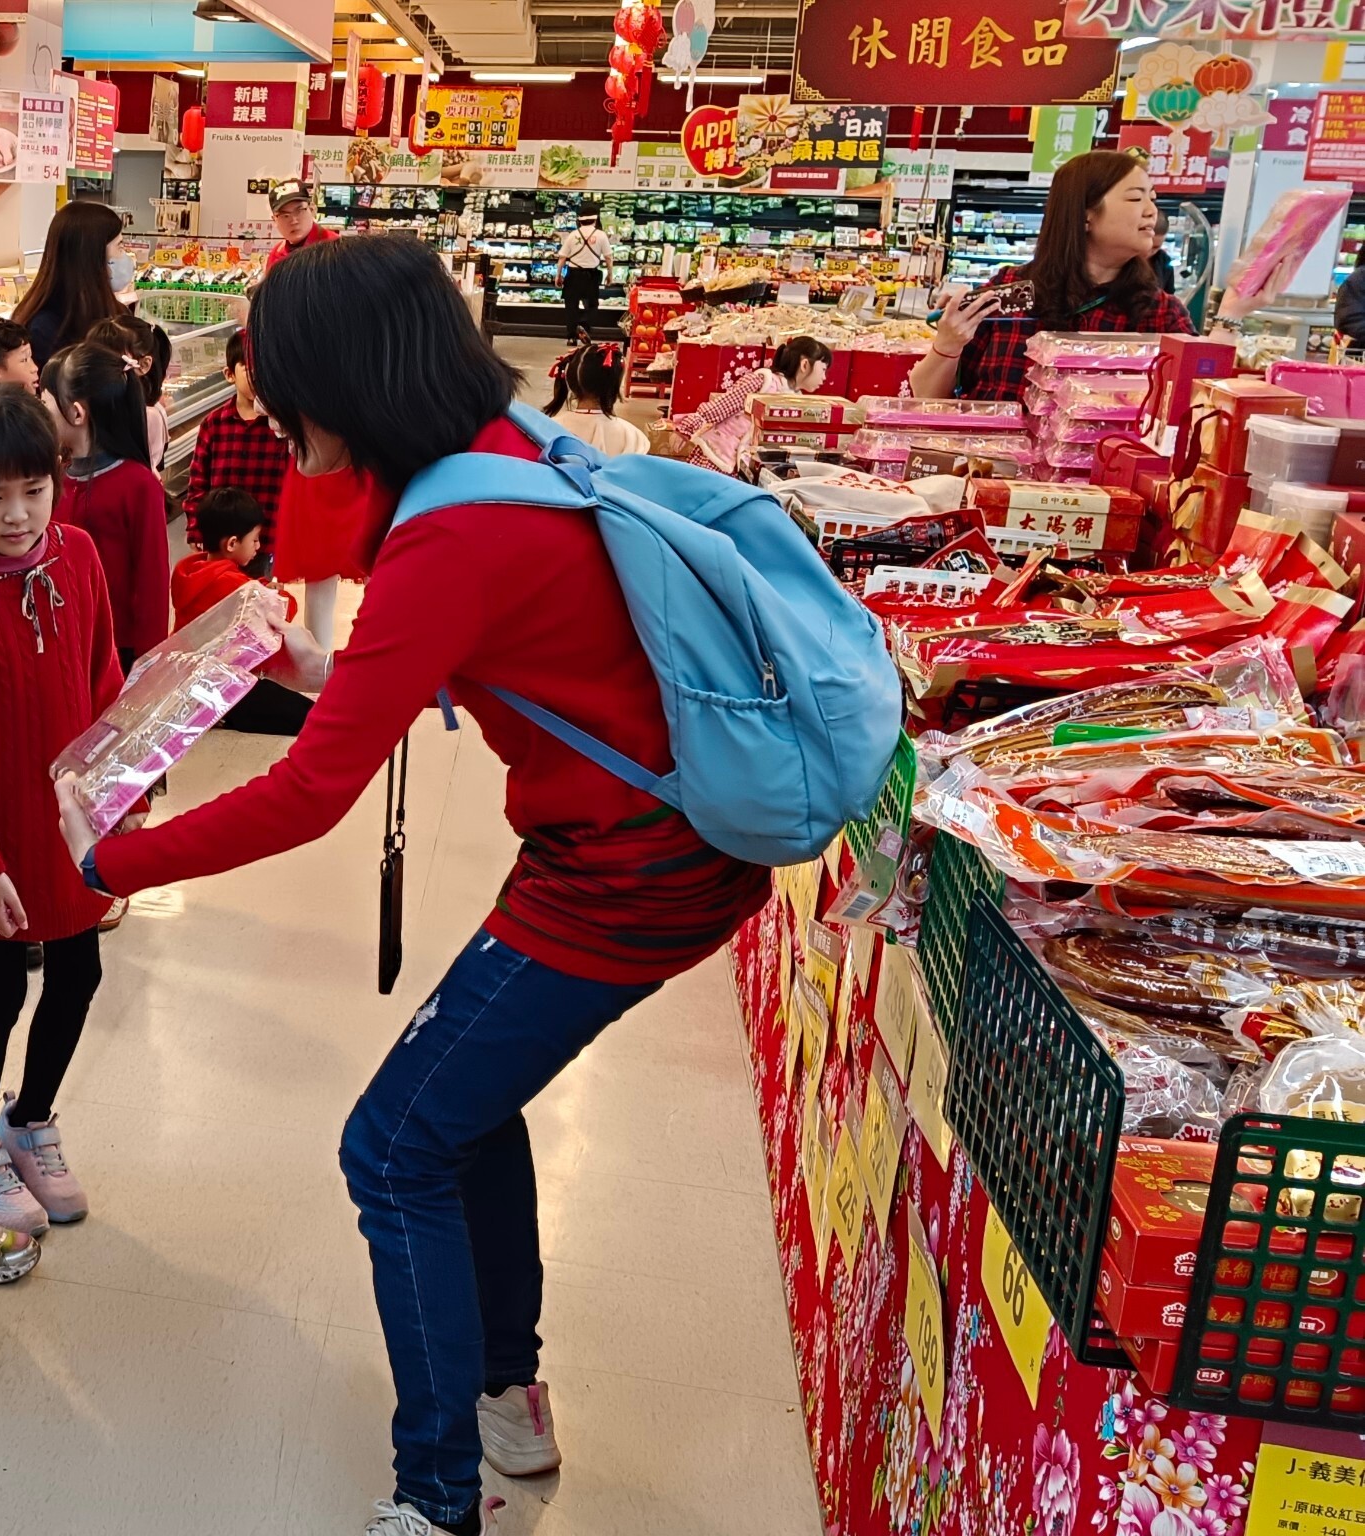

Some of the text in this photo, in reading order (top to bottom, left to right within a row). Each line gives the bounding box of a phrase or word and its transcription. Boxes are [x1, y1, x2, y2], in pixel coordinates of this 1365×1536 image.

[847, 16, 1068, 68] 休閒食品
[310, 73, 326, 91] 清
[234, 87, 268, 103] 新鮮
[26, 99, 61, 112] 特價商品
[233, 106, 267, 122] 蔬果
[845, 118, 882, 137] 日本
[211, 133, 233, 142] Fruits
[243, 134, 282, 143] Vegetables
[791, 140, 880, 161] 蘋果專區
[487, 154, 534, 166] 新鮮菇類
[43, 165, 60, 179] 54
[162, 253, 178, 264] 99
[744, 258, 759, 267] 59
[835, 261, 849, 271] 59
[879, 262, 894, 272] 59
[1310, 1270, 1329, 1279] 原味
[1002, 1240, 1029, 1327] 66
[918, 1300, 938, 1388] 199
